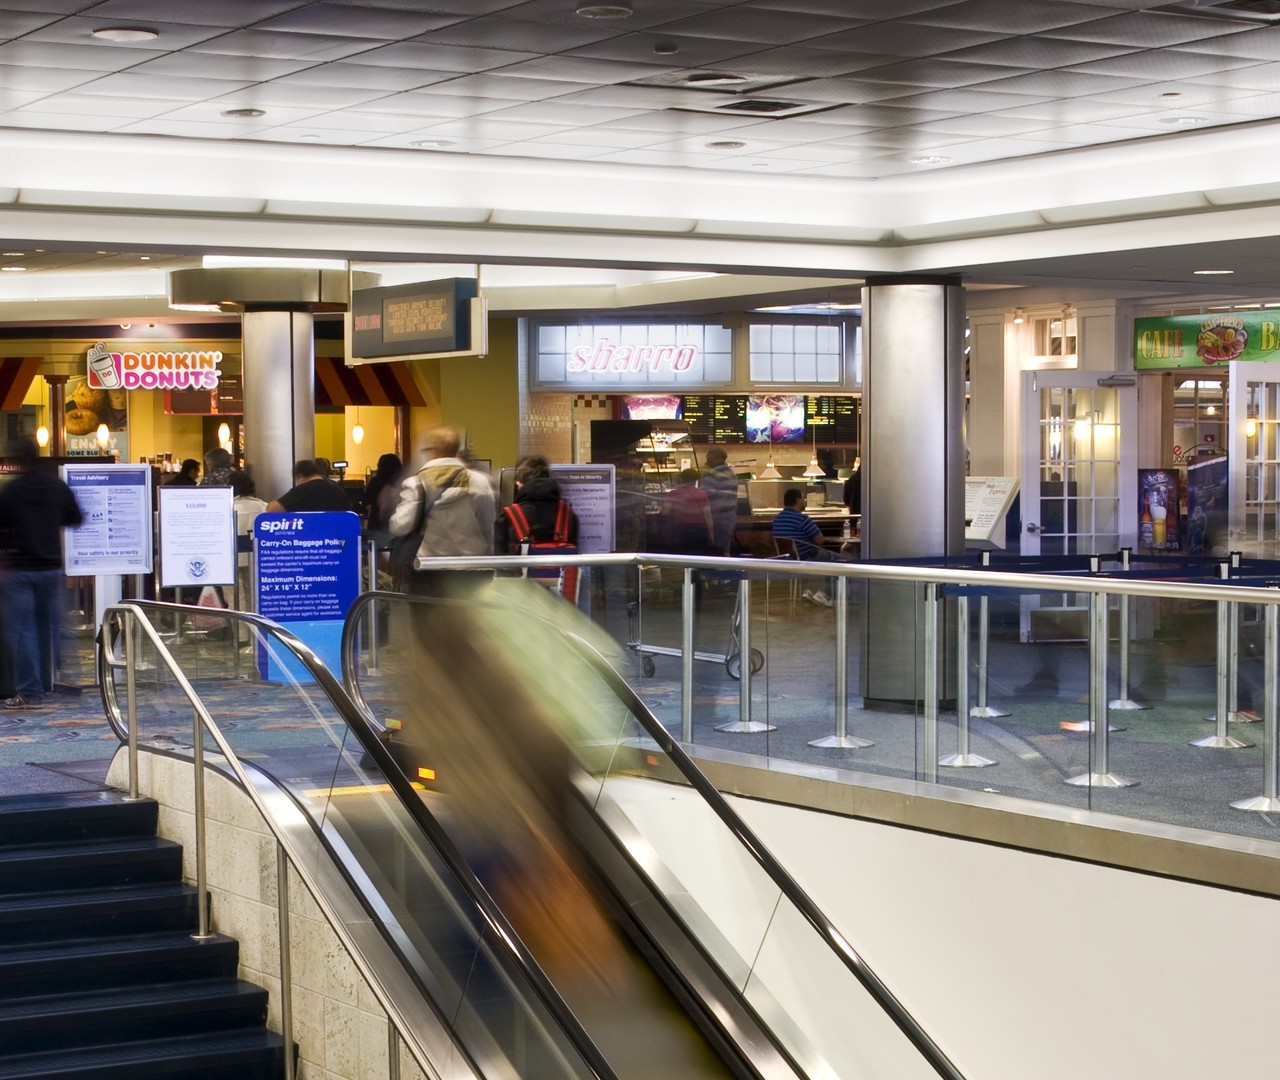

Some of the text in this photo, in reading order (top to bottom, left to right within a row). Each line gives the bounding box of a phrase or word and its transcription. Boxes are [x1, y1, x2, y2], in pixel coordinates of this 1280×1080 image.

[1140, 328, 1184, 360] CAFE
[124, 353, 220, 370] DUNKIN'
[567, 338, 698, 373] sbarro
[124, 371, 218, 388] DONUTS
[70, 438, 118, 450] ENJY
[260, 518, 304, 533] spirit
[260, 539, 346, 548] Carry-On Baggage Policy
